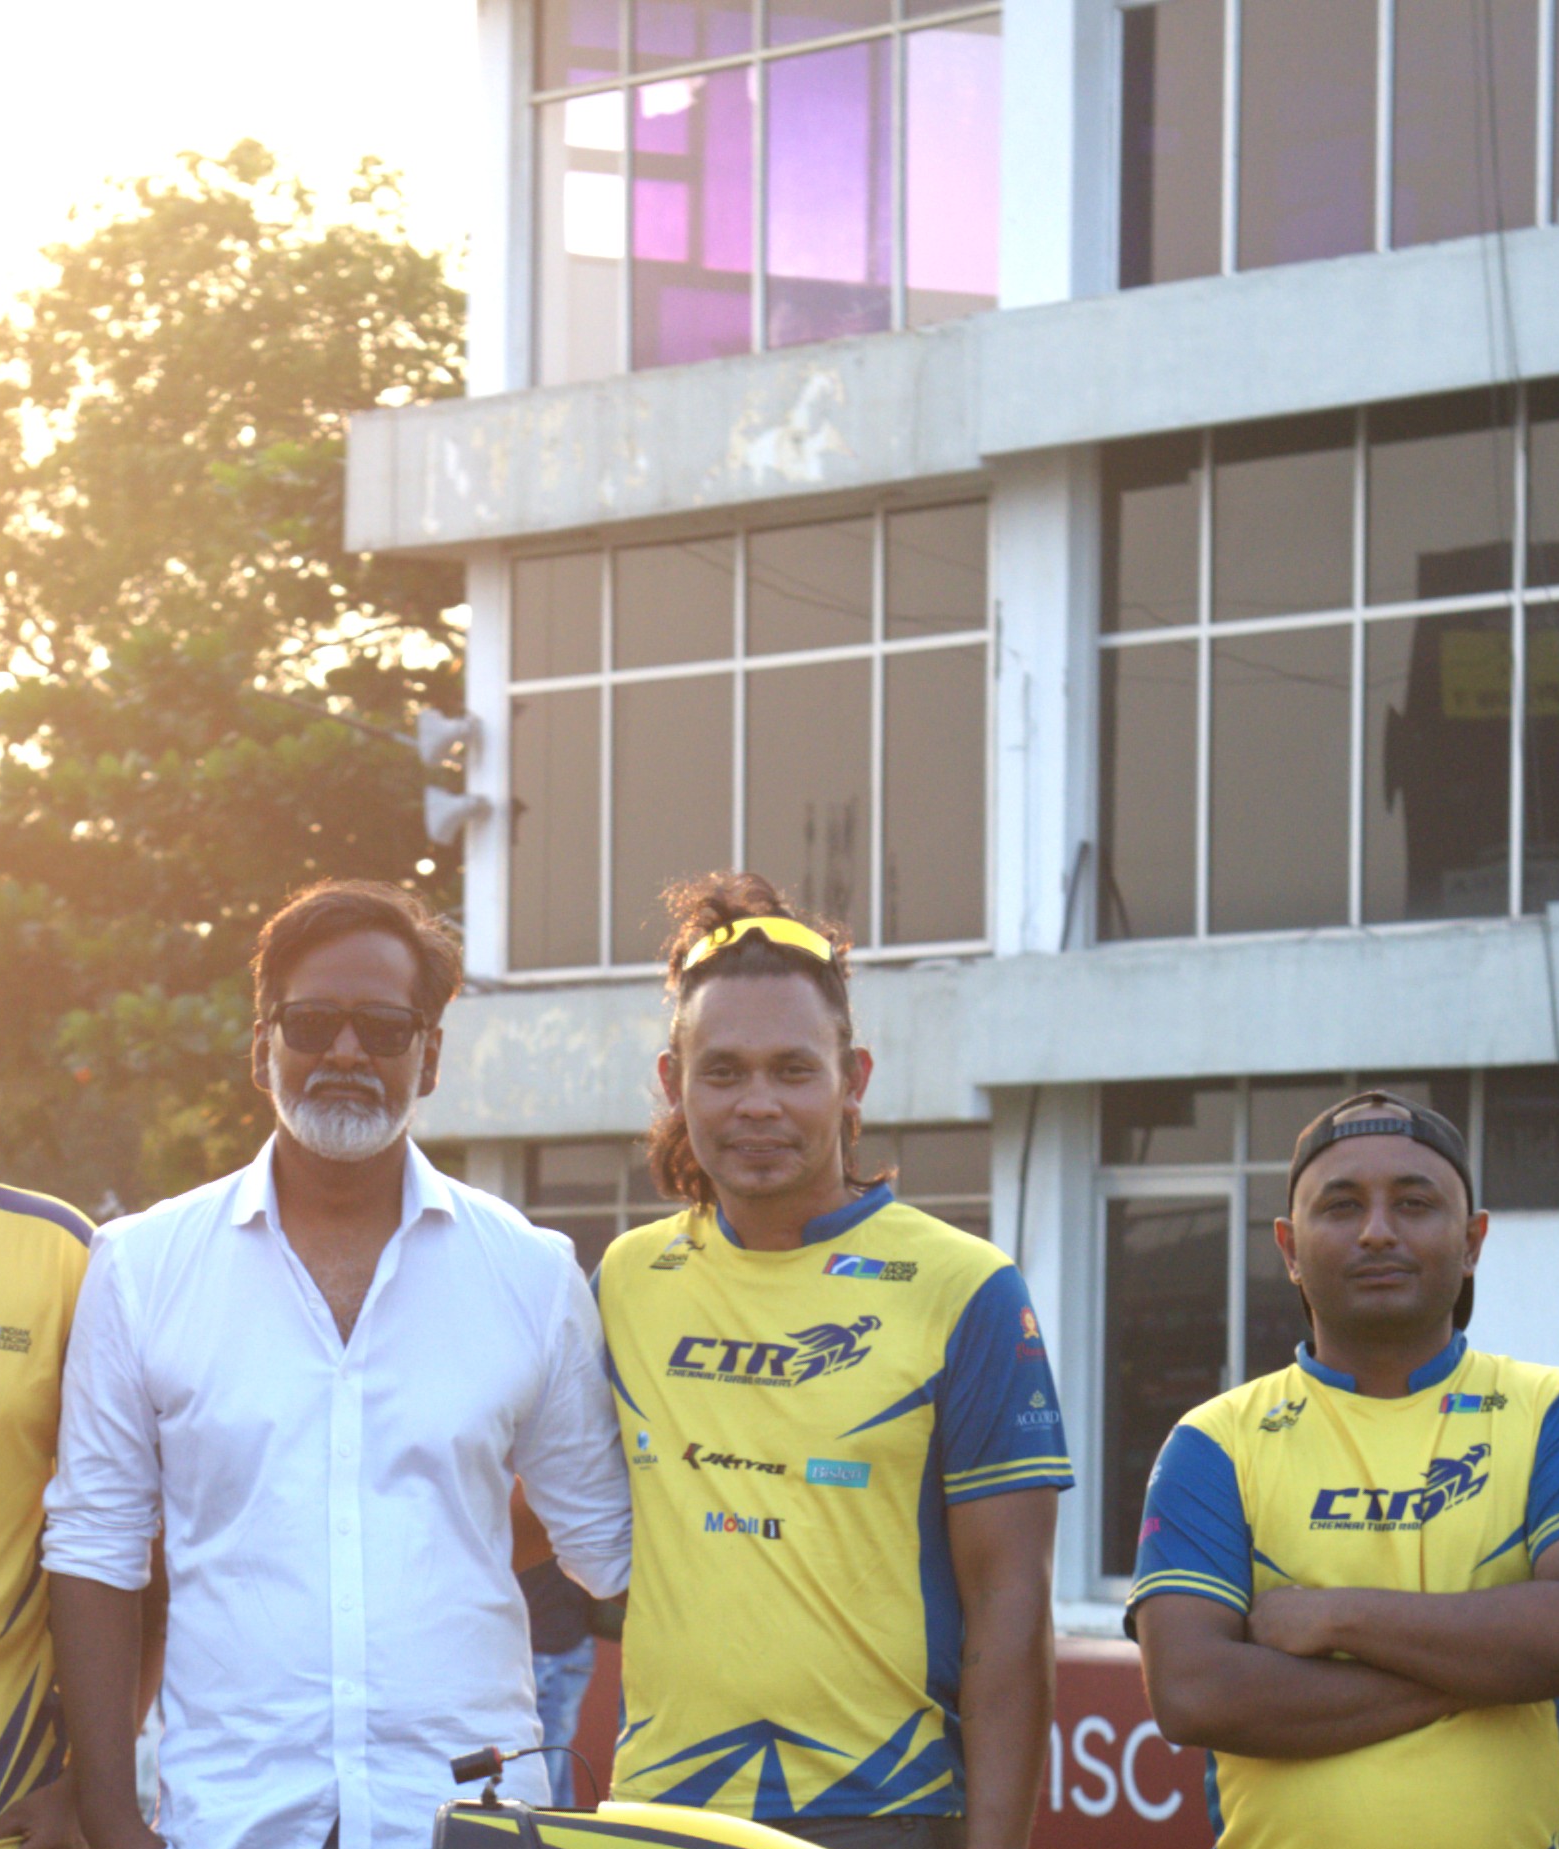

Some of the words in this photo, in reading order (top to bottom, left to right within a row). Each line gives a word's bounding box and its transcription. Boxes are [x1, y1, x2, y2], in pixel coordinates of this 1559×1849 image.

[668, 1336, 799, 1376] CTR
[704, 1511, 759, 1534] Mobil
[1309, 1521, 1365, 1531] CHENNAI
